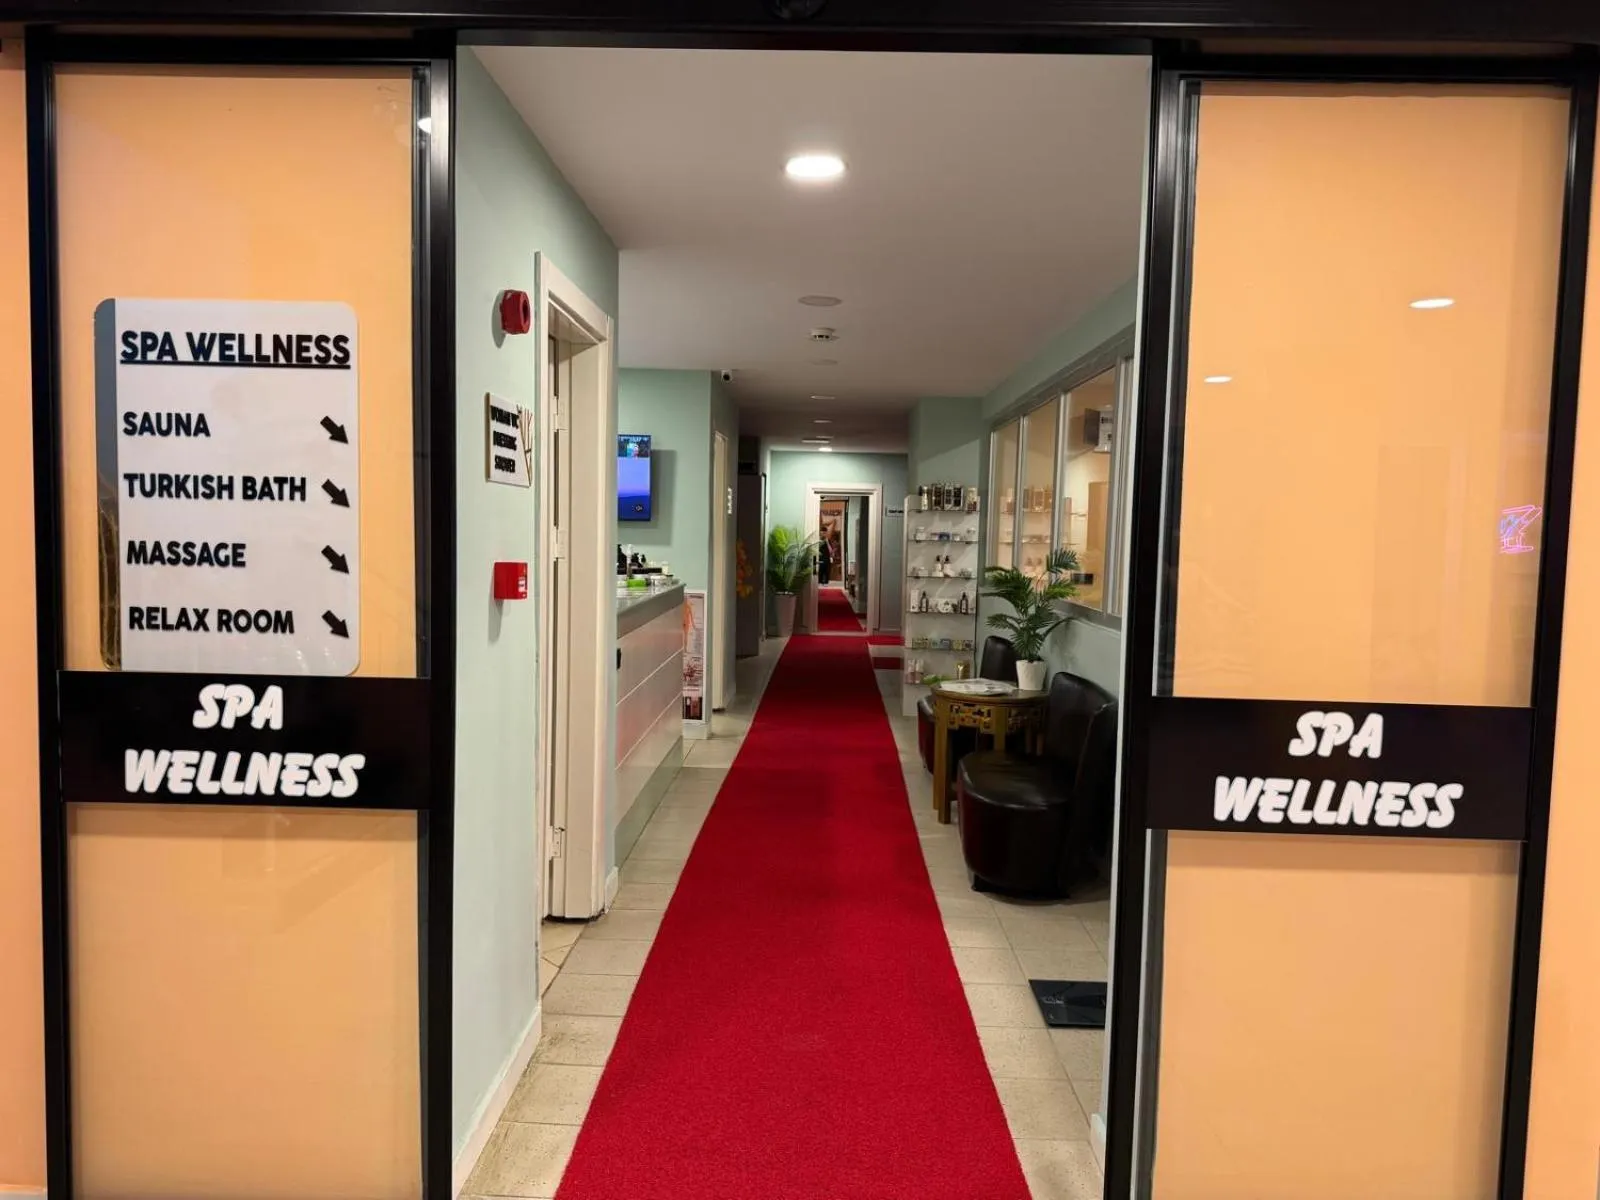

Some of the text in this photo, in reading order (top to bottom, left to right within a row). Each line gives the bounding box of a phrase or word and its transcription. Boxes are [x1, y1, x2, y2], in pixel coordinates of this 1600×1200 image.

[120, 330, 351, 365] SPA WELLNESS
[122, 411, 211, 438] SAUNA
[123, 472, 307, 502] TURKISH BATH
[126, 540, 247, 568] MASSAGE
[128, 606, 295, 635] RELAX ROOM
[192, 683, 284, 730] SPA
[1288, 710, 1384, 759] SPA
[124, 748, 366, 798] WELLNESS
[1213, 775, 1464, 829] WELLNESS
